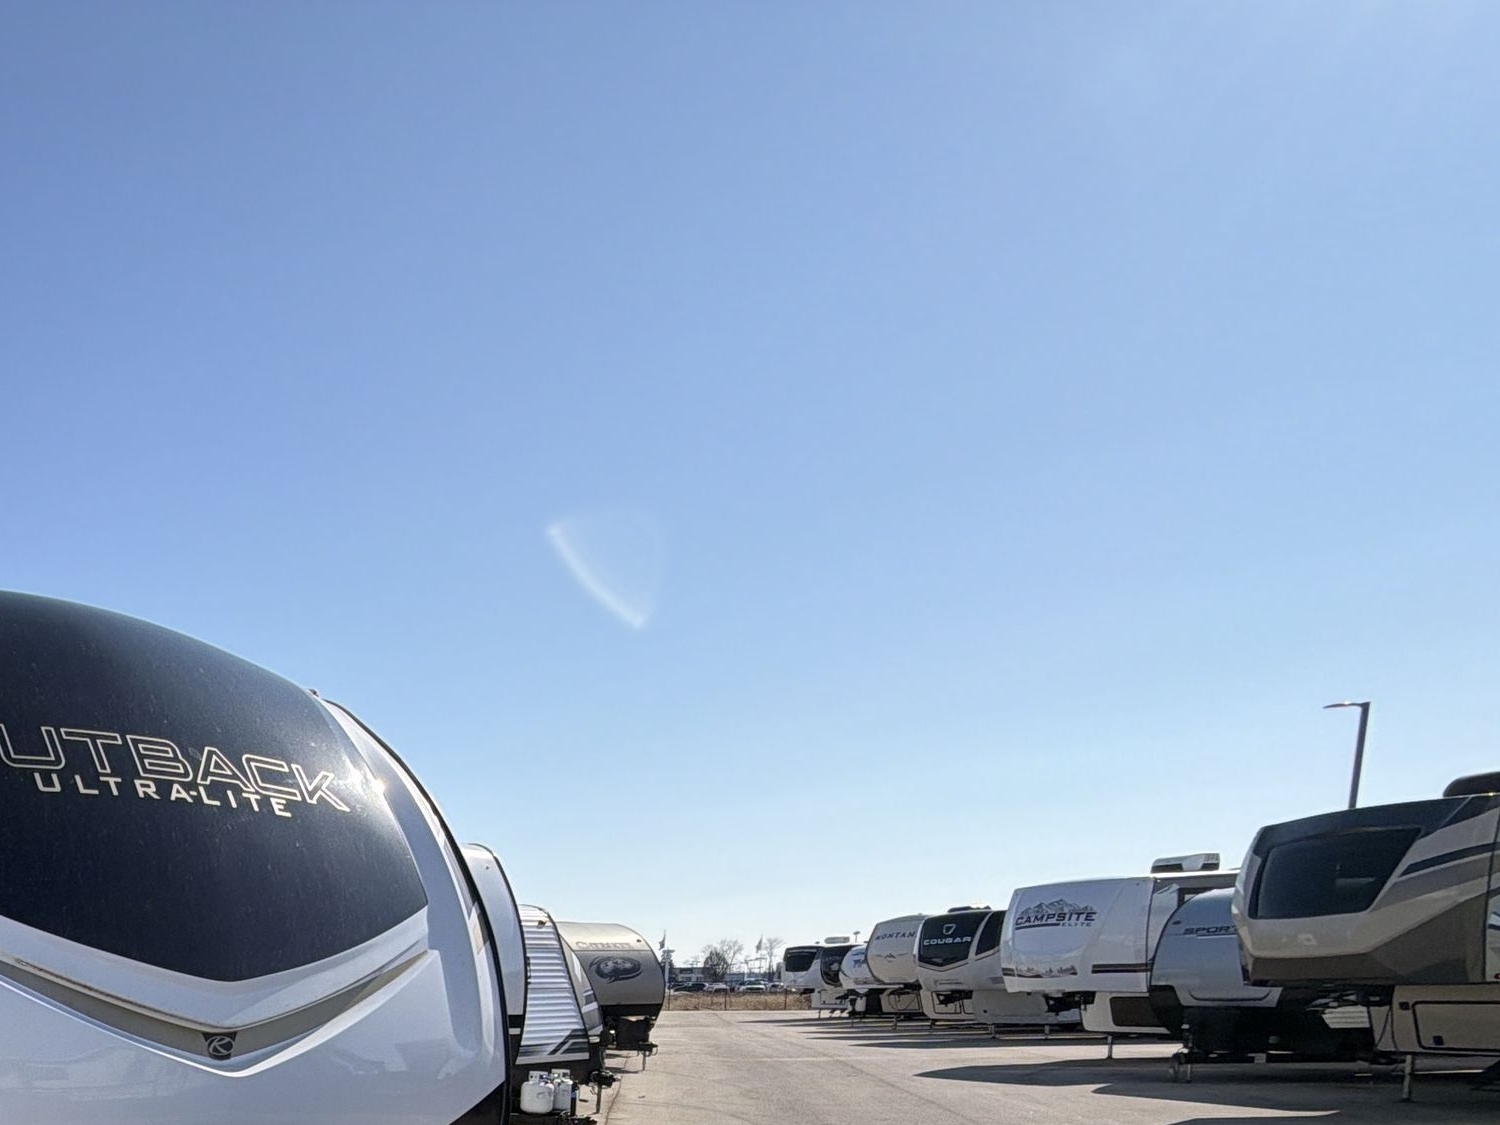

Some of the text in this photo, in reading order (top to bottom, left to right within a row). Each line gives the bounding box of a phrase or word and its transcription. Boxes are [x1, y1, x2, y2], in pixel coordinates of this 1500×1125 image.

[33, 772, 292, 818] ULTRA-LITE
[1015, 911, 1098, 926] CAMPSITE
[875, 931, 917, 941] MONTAN
[923, 936, 973, 946] COUGAR
